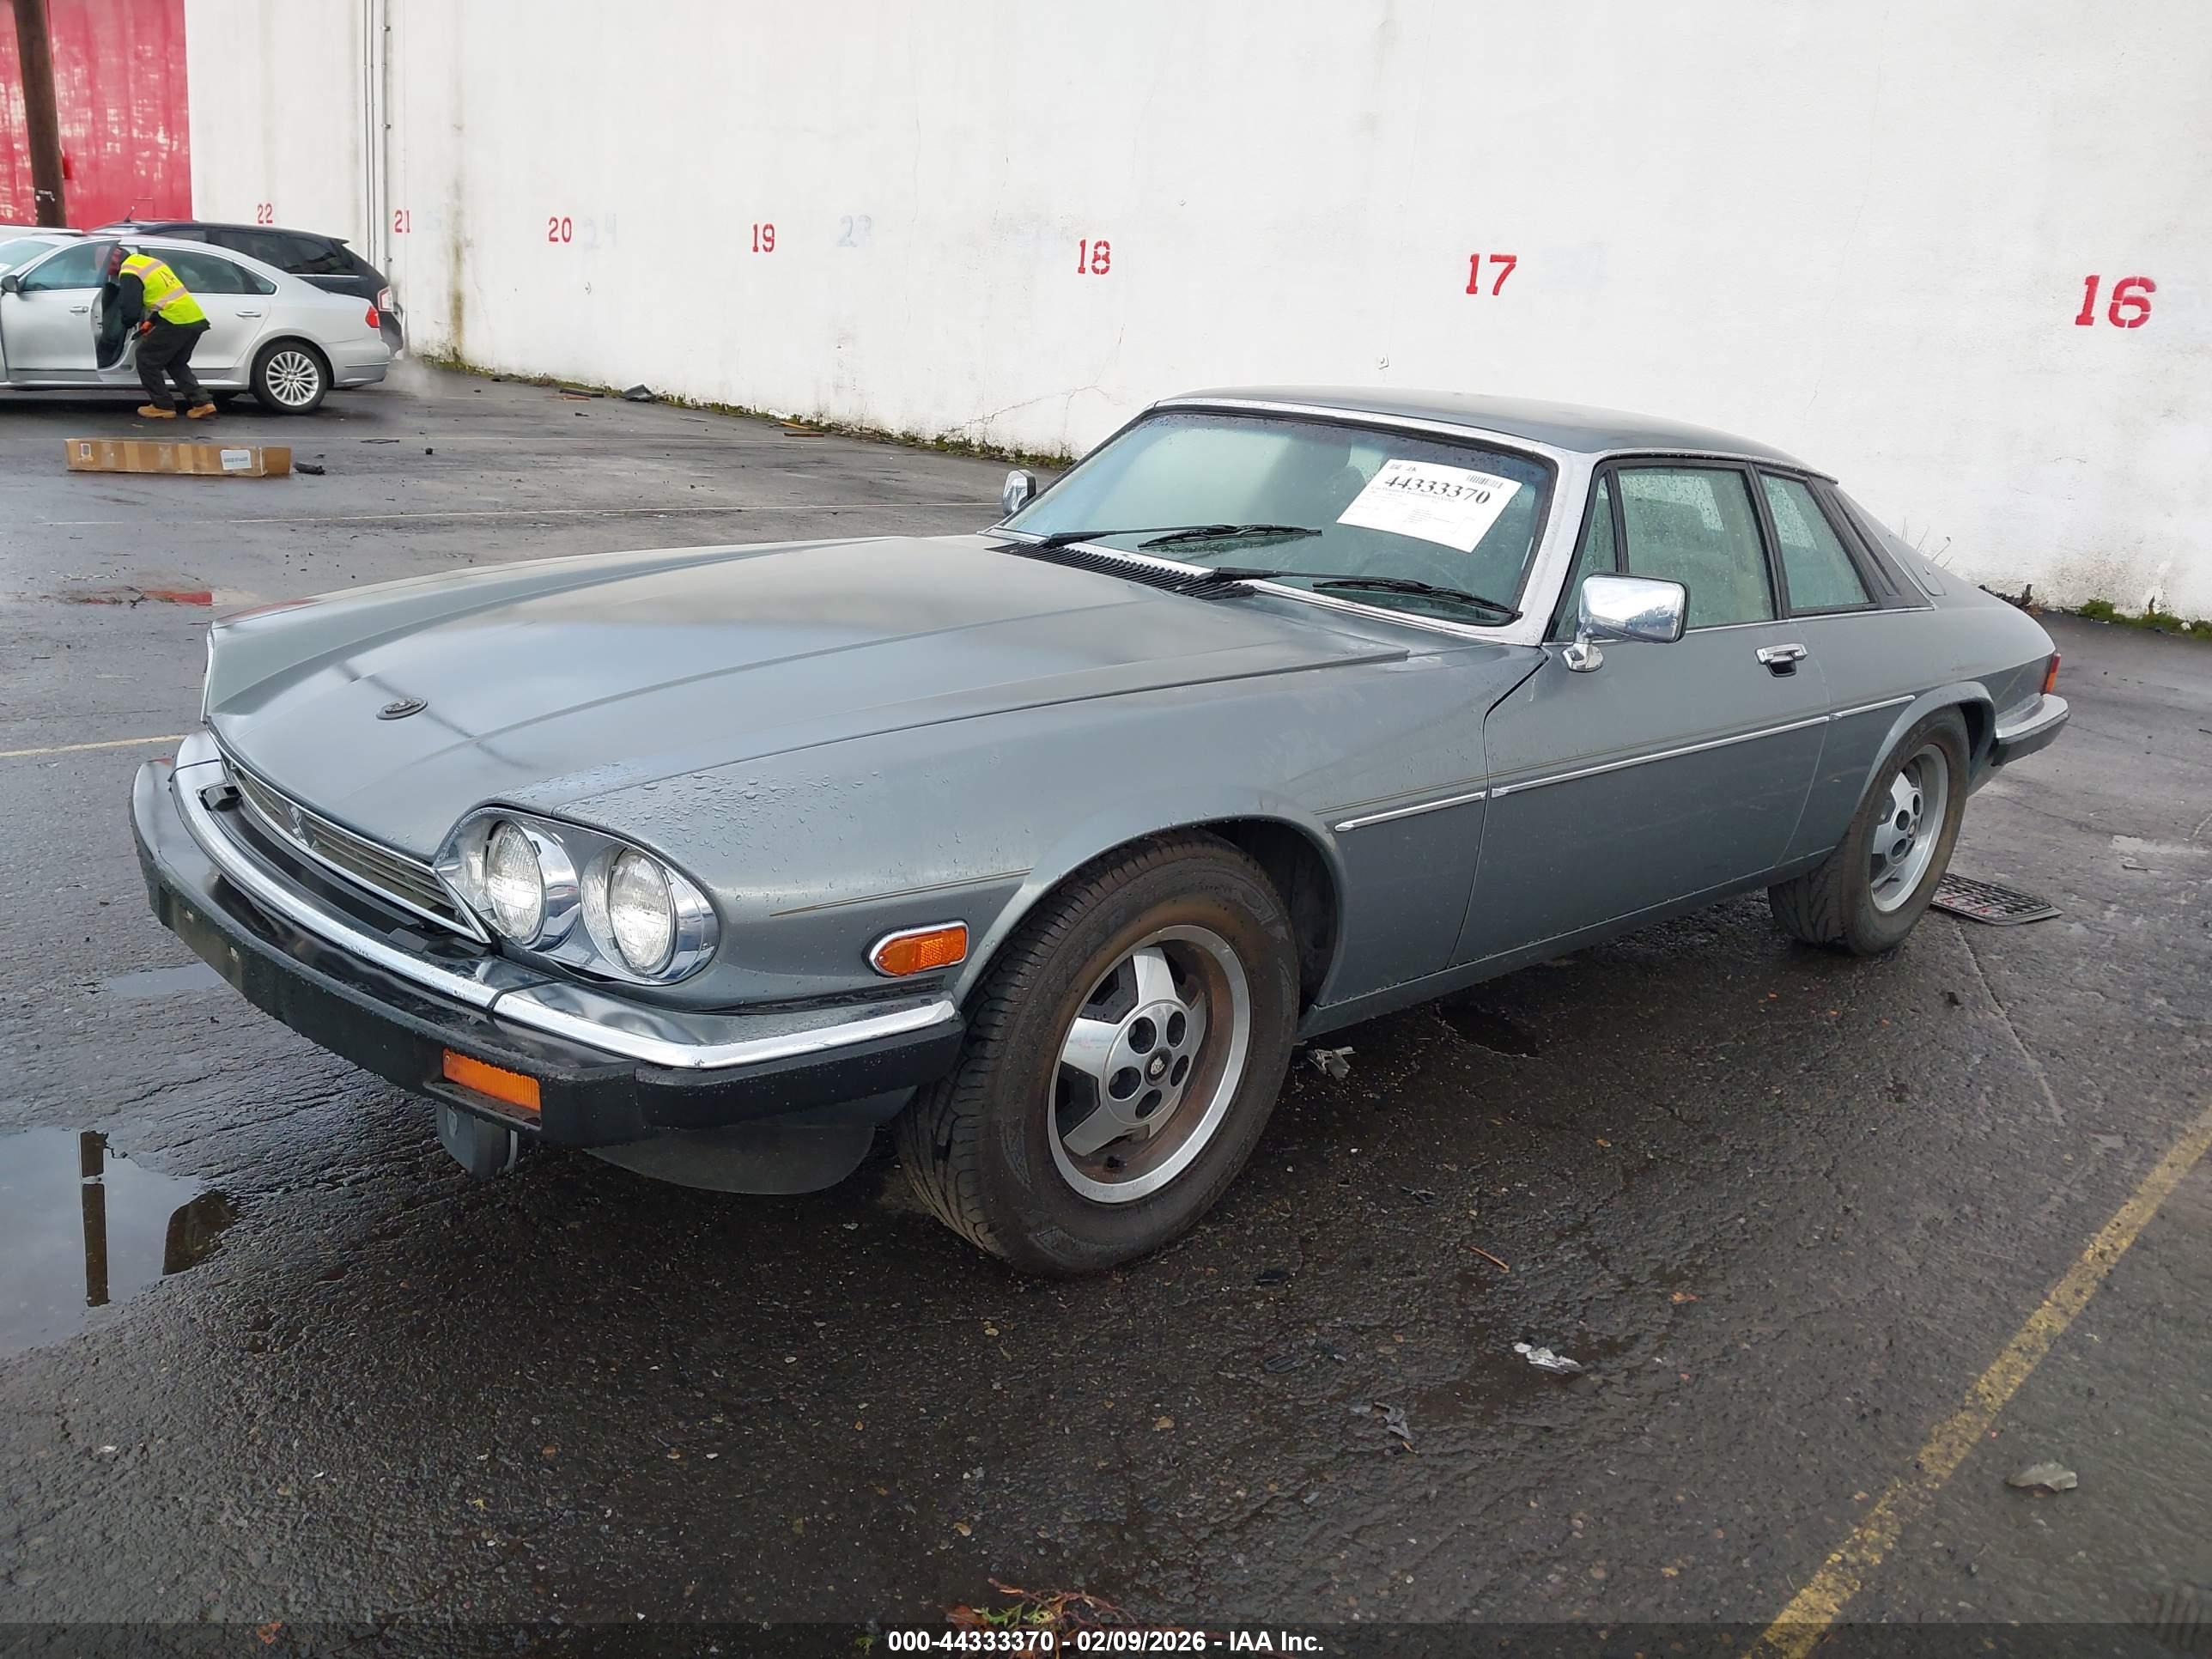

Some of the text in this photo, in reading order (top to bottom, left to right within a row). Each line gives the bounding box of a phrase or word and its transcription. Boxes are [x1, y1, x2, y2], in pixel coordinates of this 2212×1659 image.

[257, 204, 274, 224] 22
[394, 210, 410, 234] 21
[547, 216, 573, 244] 20
[751, 223, 775, 253] 19
[1077, 239, 1111, 276] 18
[1465, 252, 1518, 297] 17
[2074, 274, 2158, 329] 16
[1384, 475, 1492, 505] 44333370
